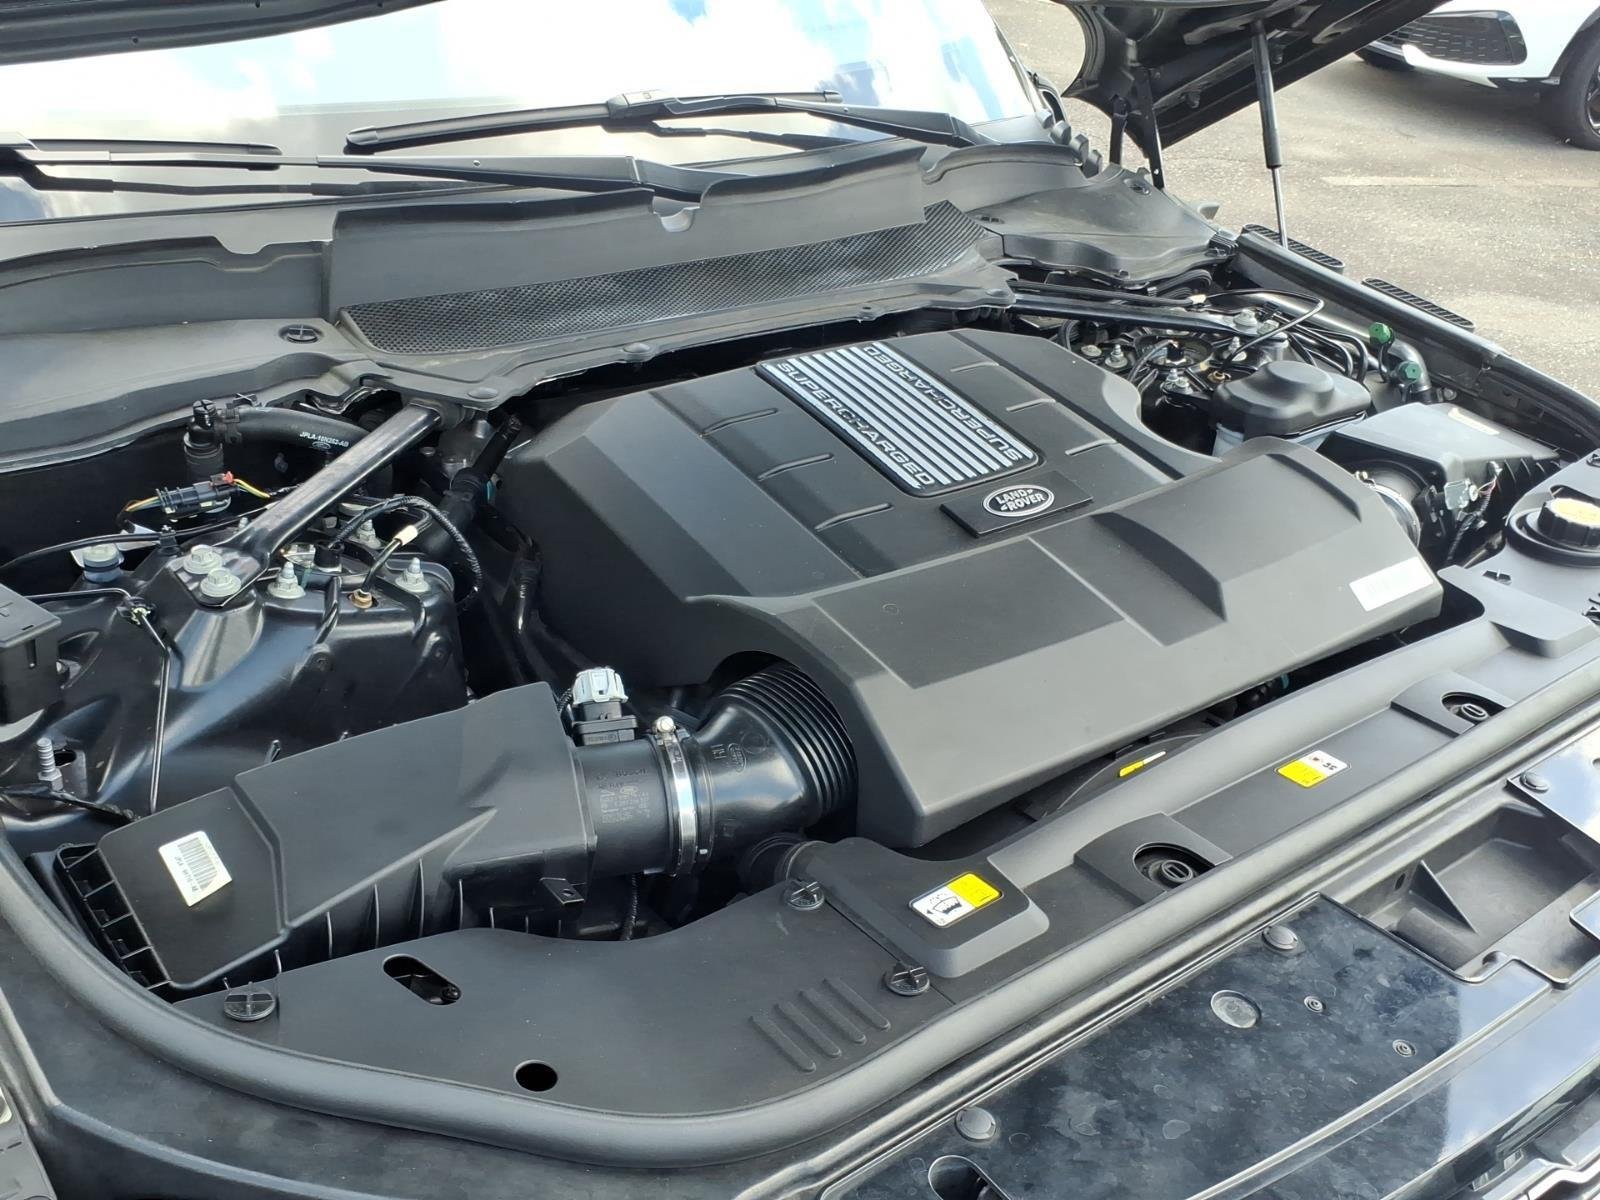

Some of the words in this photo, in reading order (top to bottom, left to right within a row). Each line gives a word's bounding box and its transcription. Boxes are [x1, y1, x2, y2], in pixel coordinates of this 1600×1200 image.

[776, 363, 934, 485] SUPERCHARGED
[864, 346, 1022, 461] SUPERCHARGED
[995, 489, 1027, 504] LAND
[1006, 493, 1045, 511] ROVER
